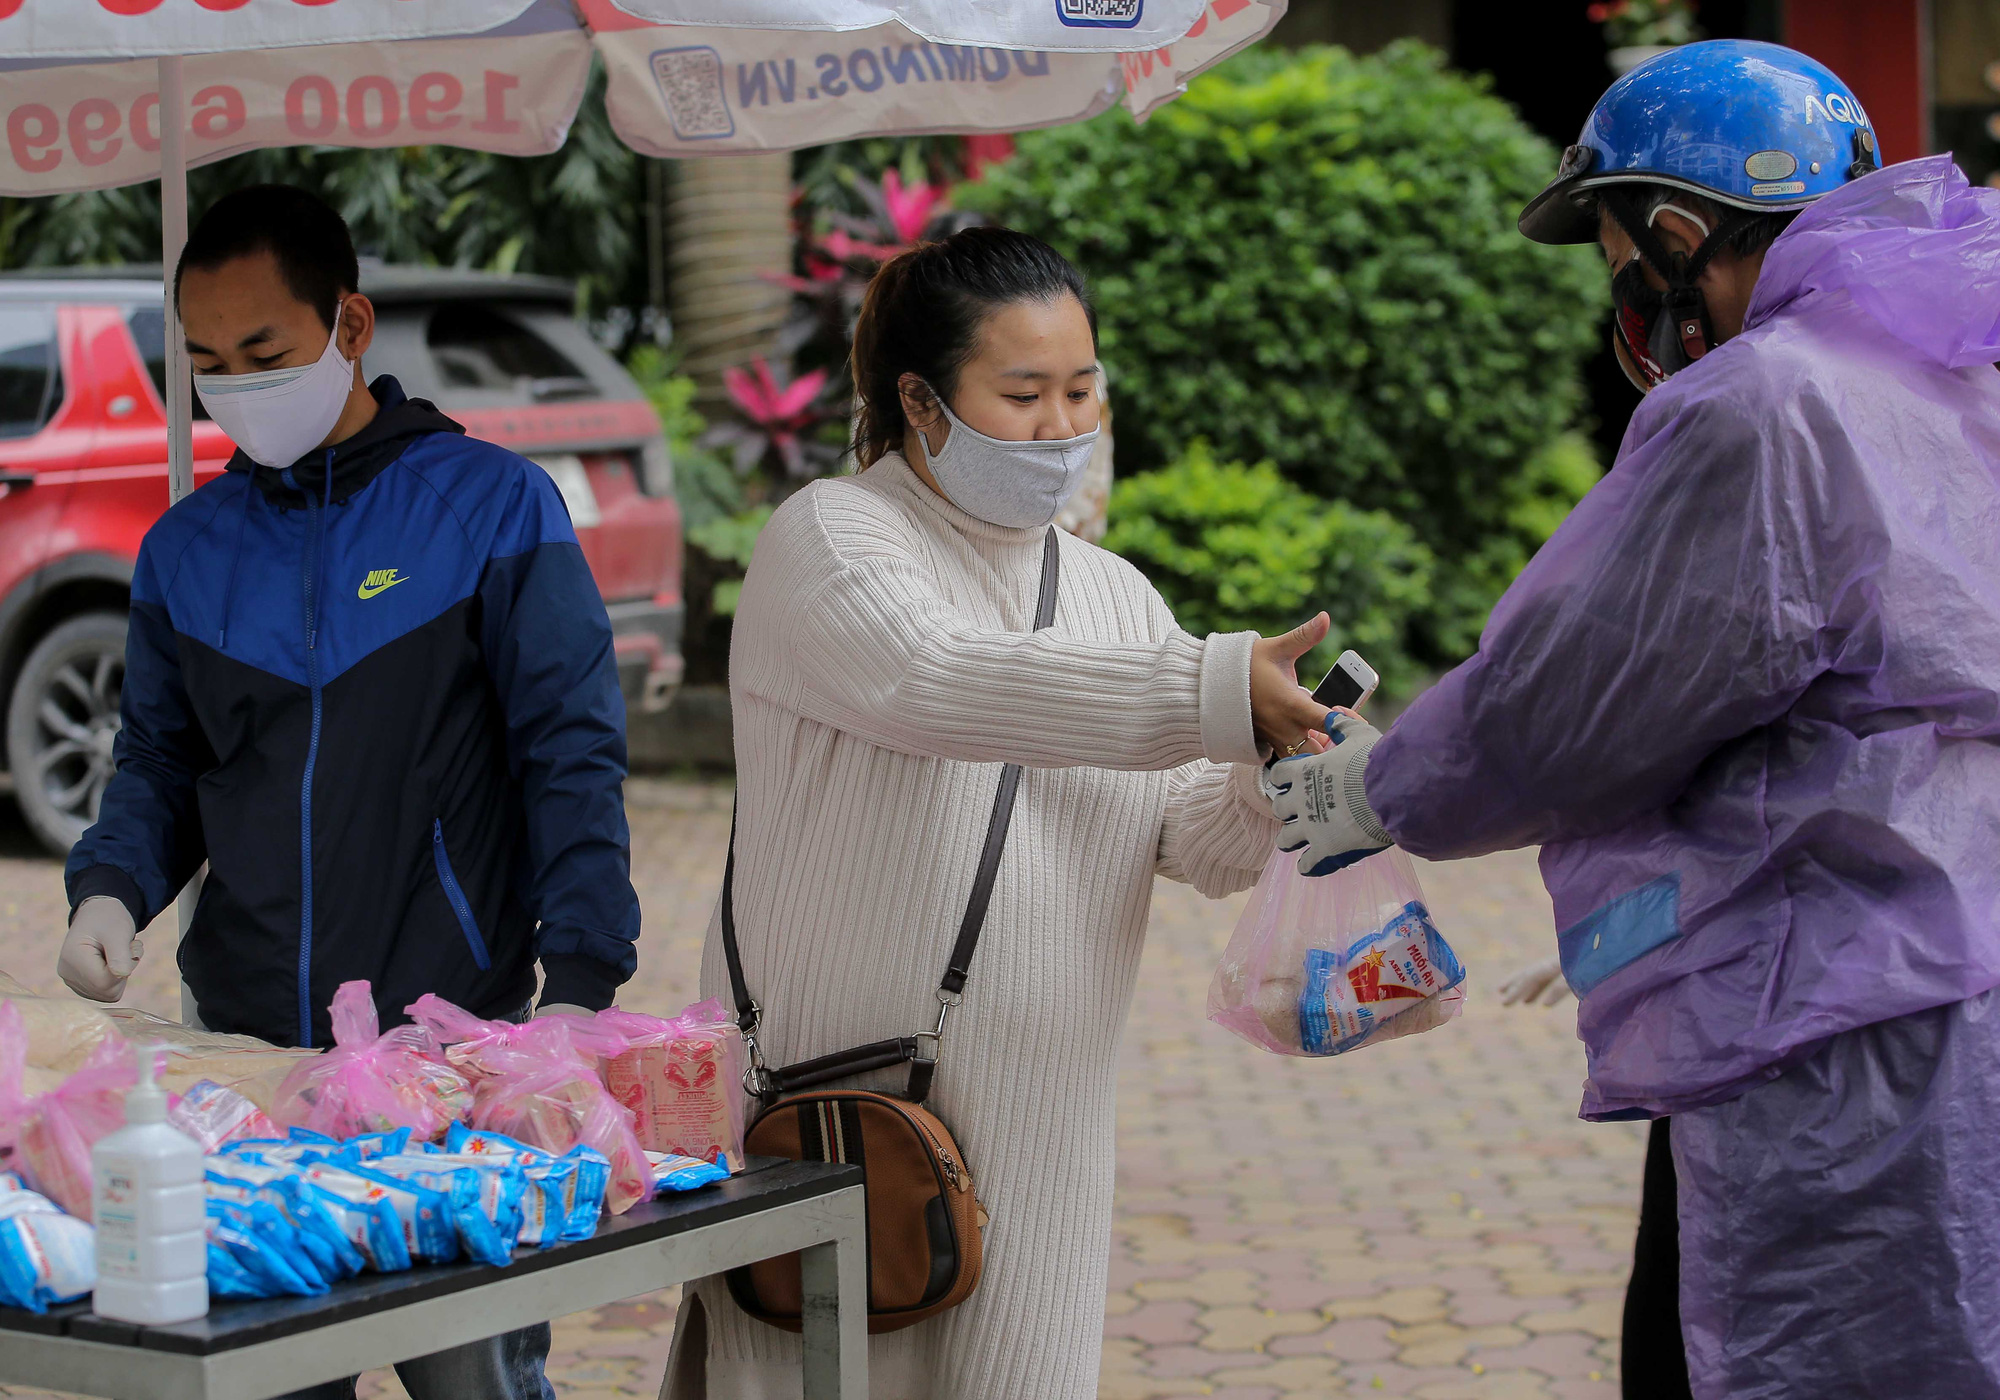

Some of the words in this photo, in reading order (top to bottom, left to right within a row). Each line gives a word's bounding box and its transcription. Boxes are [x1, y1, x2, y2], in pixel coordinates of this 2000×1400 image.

[364, 568, 398, 586] NIKE
[1406, 943, 1428, 972] MUỐI
[1388, 958, 1407, 983] ASEAN
[1403, 960, 1422, 986] SẠCH
